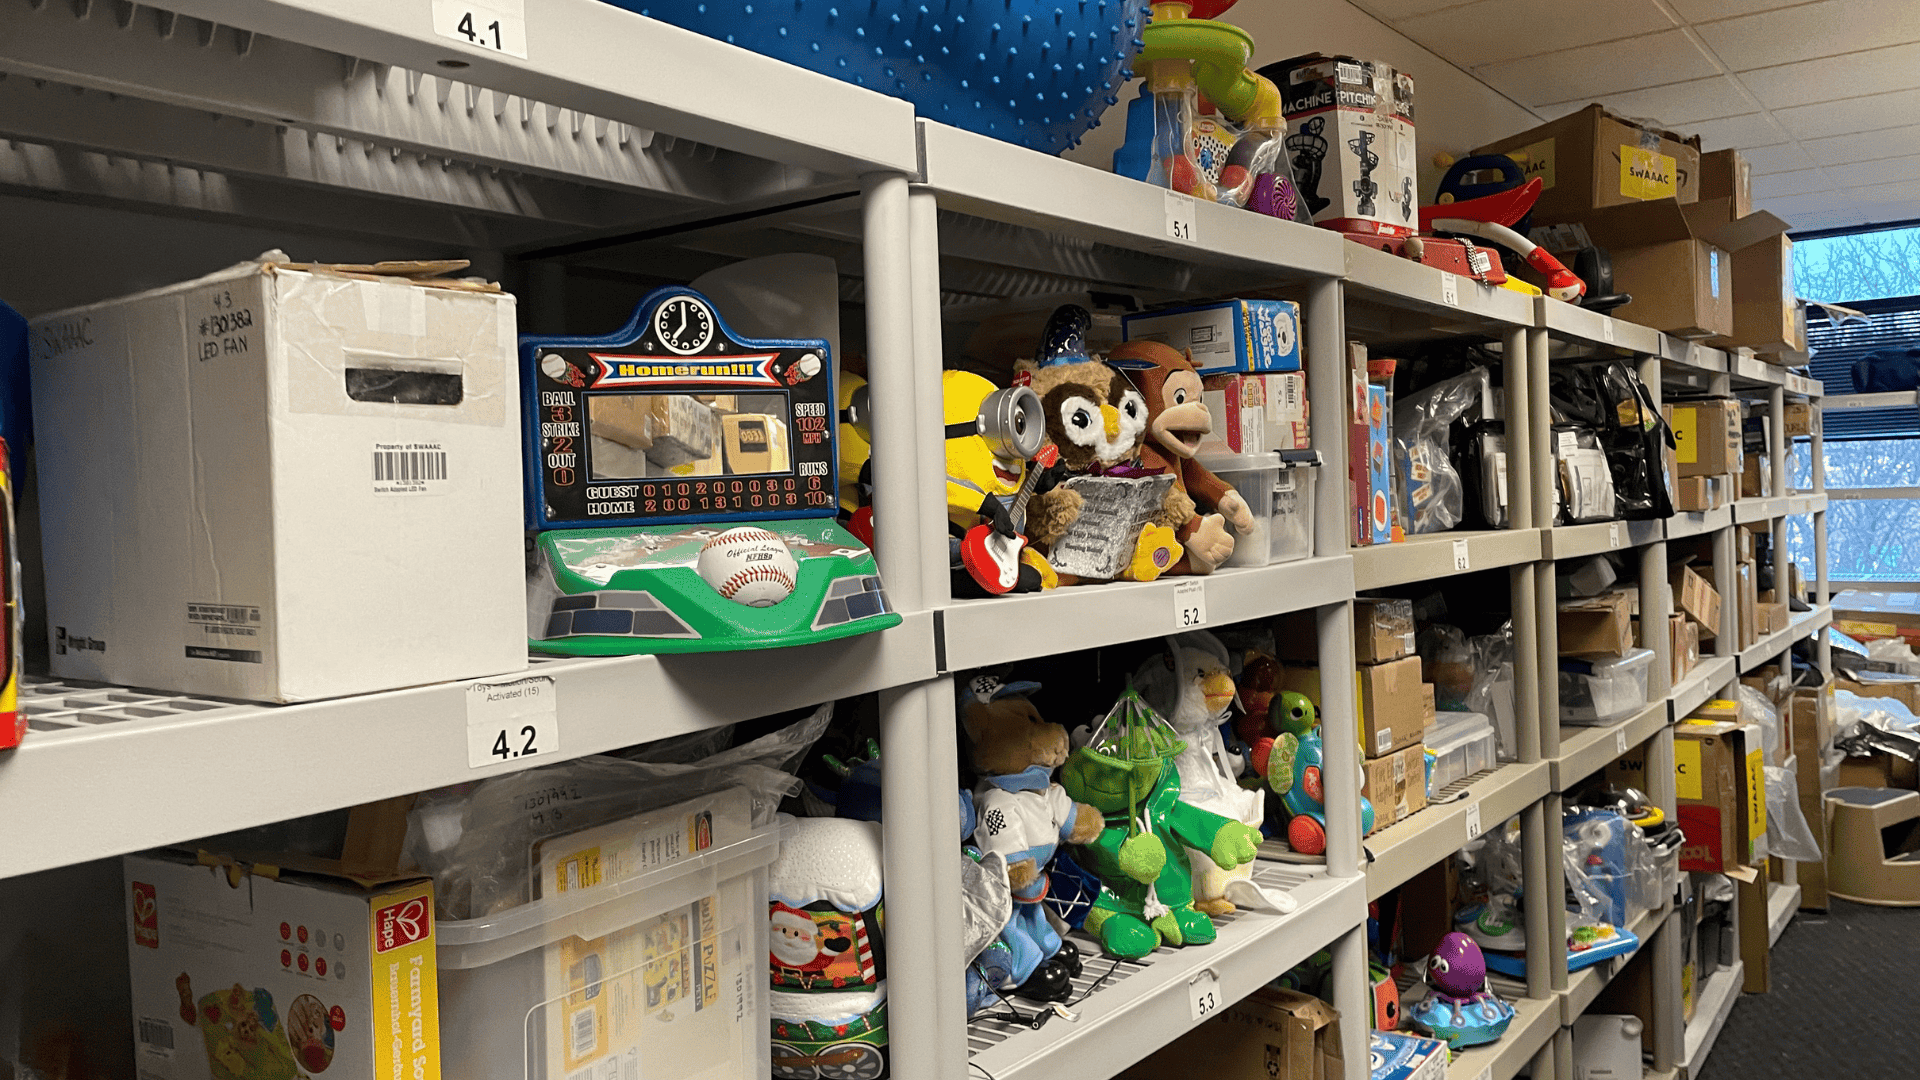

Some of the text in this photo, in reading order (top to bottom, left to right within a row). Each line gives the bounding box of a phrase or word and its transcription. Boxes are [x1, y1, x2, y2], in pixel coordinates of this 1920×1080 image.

[458, 12, 501, 50] 4.1
[1340, 91, 1377, 105] PITCHIN
[1629, 167, 1669, 185] SWAAAC
[1174, 220, 1188, 240] 5.1
[198, 335, 248, 362] LED FAN
[618, 363, 754, 378] Homerun!!!
[542, 391, 576, 406] BALL
[551, 405, 573, 423] 3
[795, 402, 826, 417] SPEED
[542, 422, 580, 437] STRIKE
[796, 416, 825, 432] 102
[552, 436, 573, 454] 2
[802, 432, 821, 444] MPH
[547, 452, 576, 468] OUT
[798, 462, 828, 477] RUNS
[586, 485, 639, 500] GUEST
[808, 475, 821, 490] 6
[587, 501, 636, 515] HOME
[804, 490, 827, 505] 10
[726, 545, 784, 558] Official League
[1183, 607, 1200, 626] 5.2
[486, 686, 540, 702] Activated (15)
[491, 725, 538, 760] 4.2
[383, 908, 396, 948] Hape
[1199, 992, 1215, 1015] 5.3
[408, 955, 427, 1080] Farmyard So
